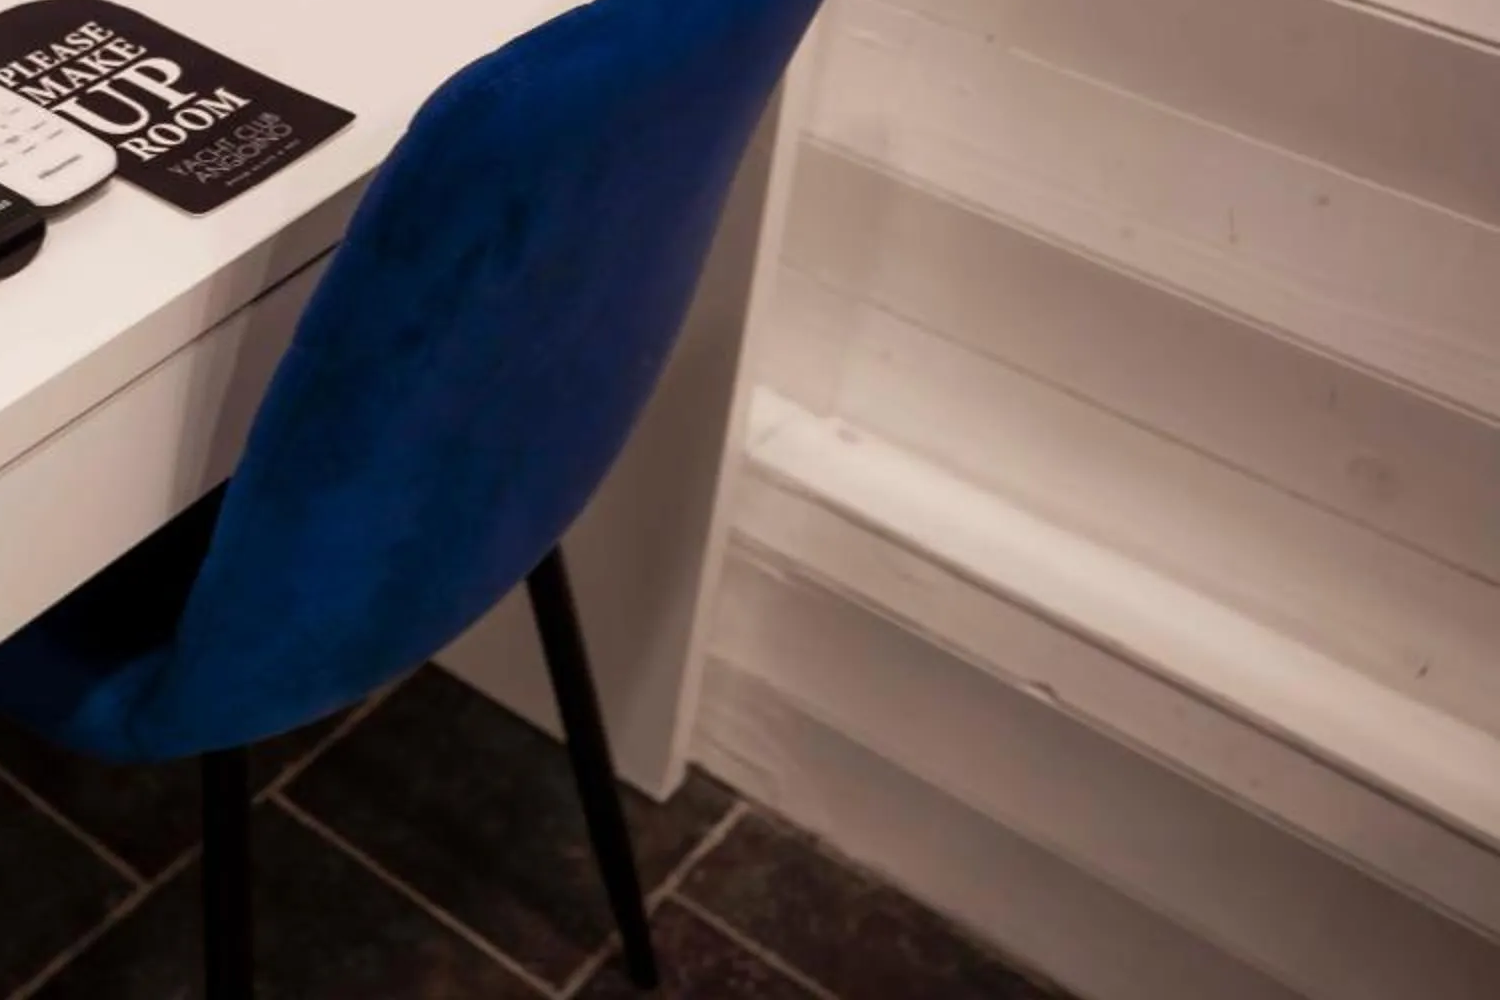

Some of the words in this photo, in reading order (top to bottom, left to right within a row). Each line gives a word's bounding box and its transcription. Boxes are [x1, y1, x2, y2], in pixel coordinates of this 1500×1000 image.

[15, 36, 148, 107] MAKE
[51, 57, 197, 136] UP
[116, 86, 253, 162] ROOM
[233, 112, 283, 141] CLUB
